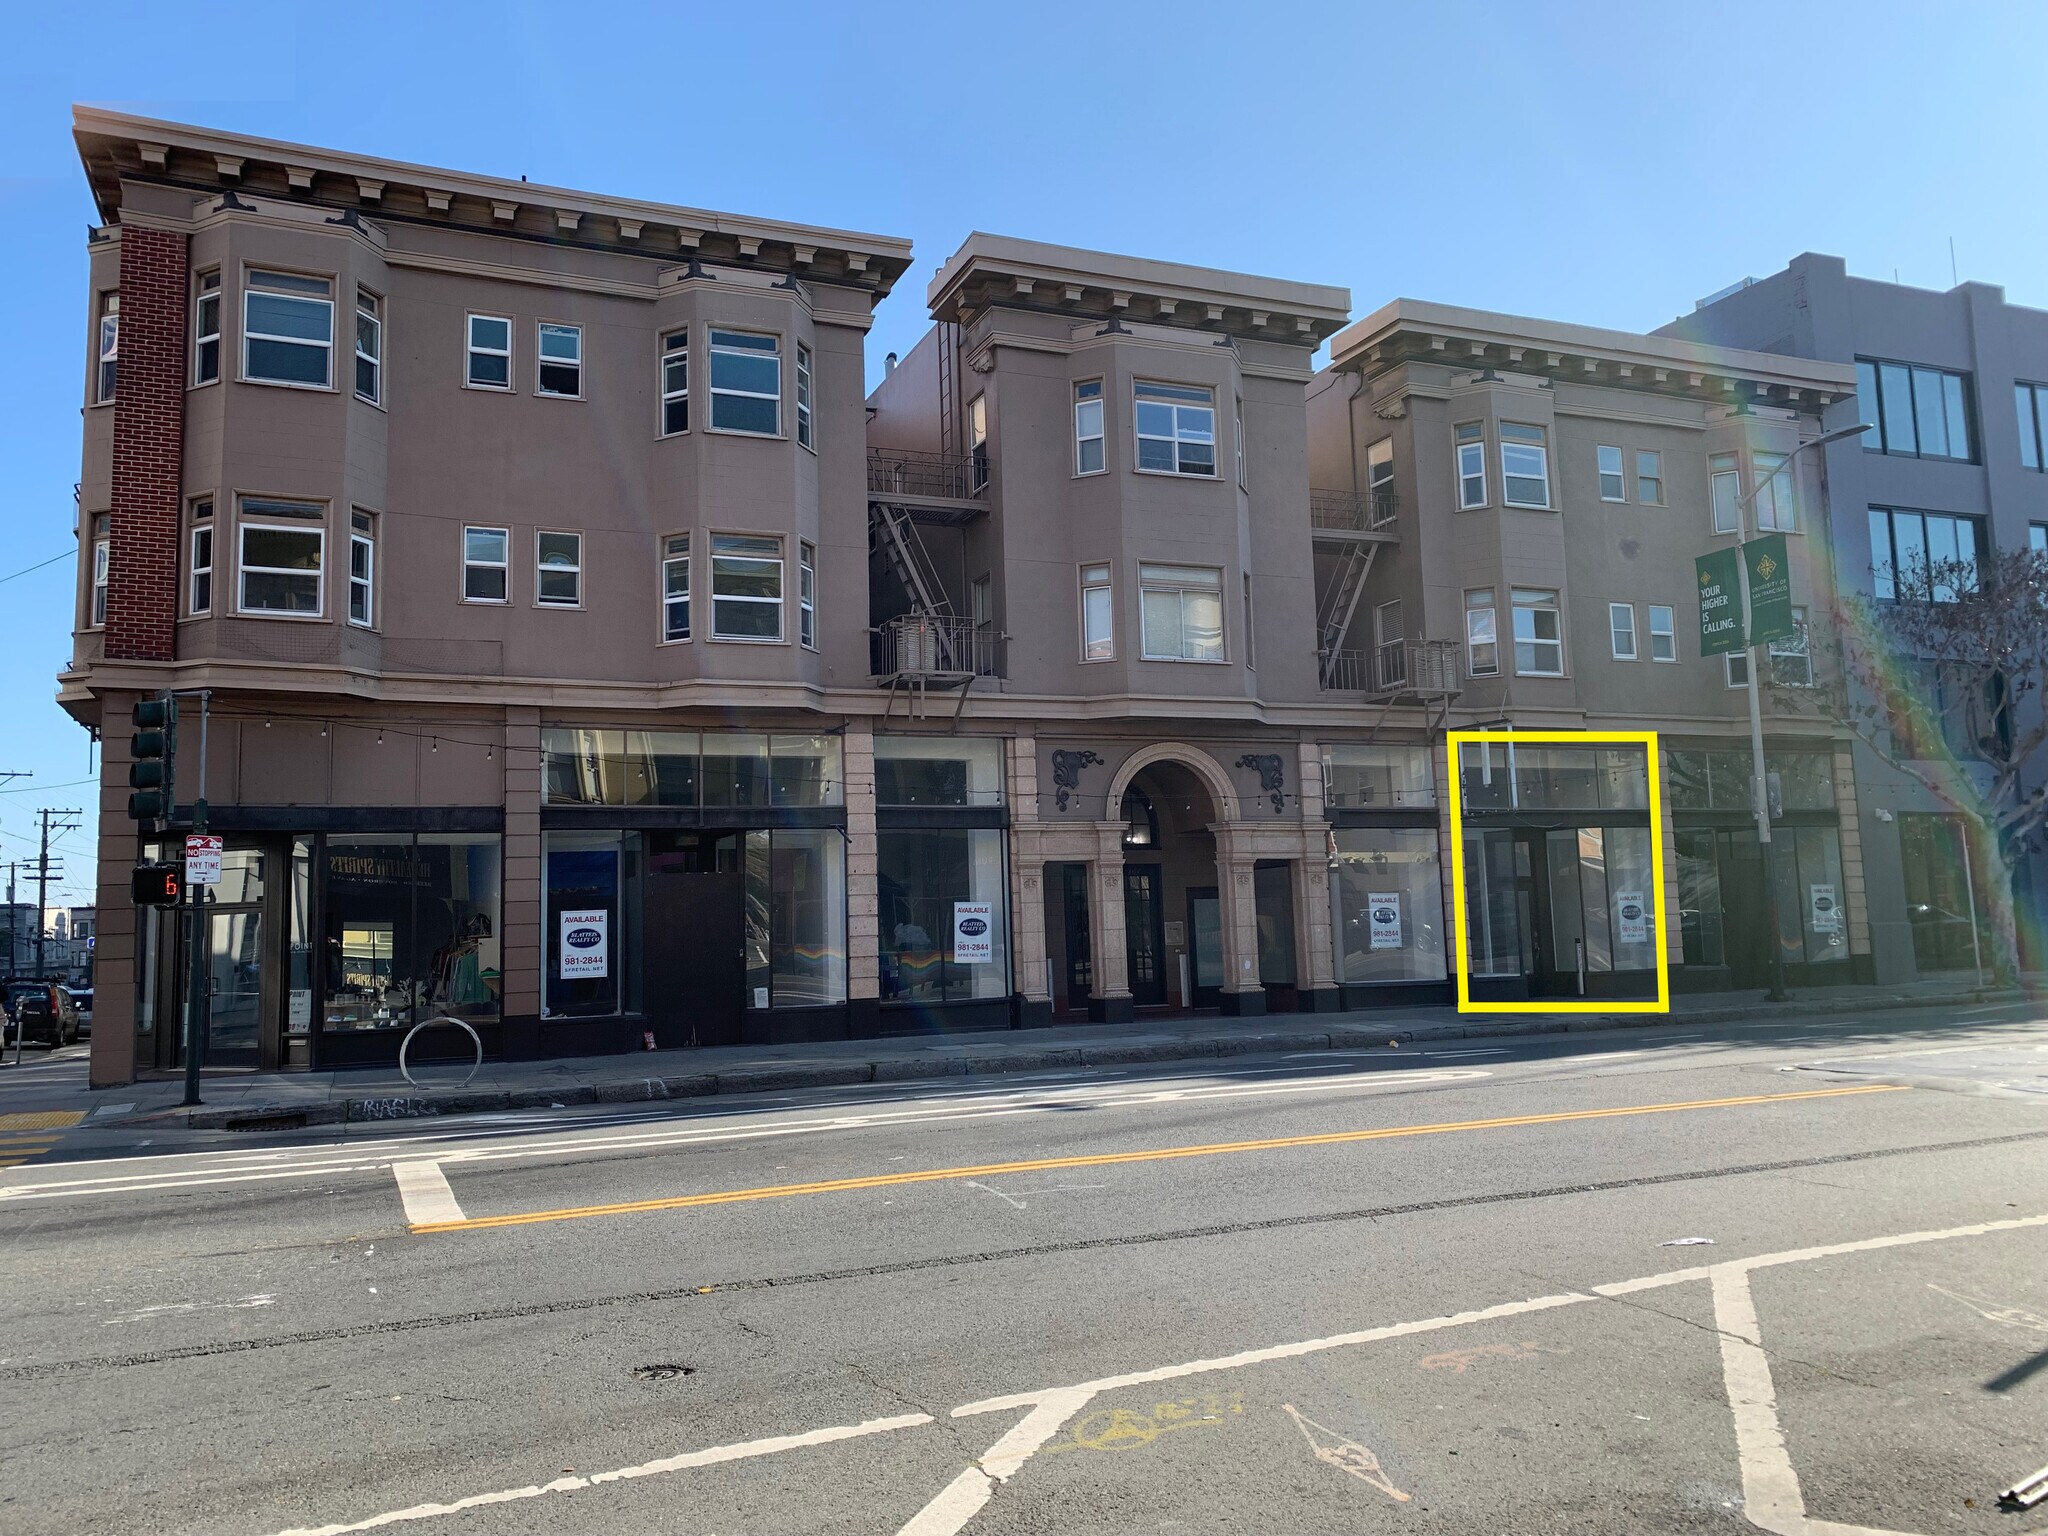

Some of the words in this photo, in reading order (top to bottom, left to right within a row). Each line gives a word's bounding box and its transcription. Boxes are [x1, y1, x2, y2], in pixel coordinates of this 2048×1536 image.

[1701, 585, 1720, 598] YOUR
[1752, 581, 1778, 592] UNIVERSITY
[1761, 586, 1787, 597] FRANCISCO
[1702, 595, 1728, 610] HIGHER
[1703, 612, 1709, 622] IS
[1703, 618, 1736, 634] CALLING.
[187, 849, 199, 857] NO
[199, 849, 221, 857] STOPPING
[189, 861, 202, 869] ANY
[205, 861, 219, 869] TIME
[166, 874, 177, 895] 6
[565, 956, 603, 966] 981-2844
